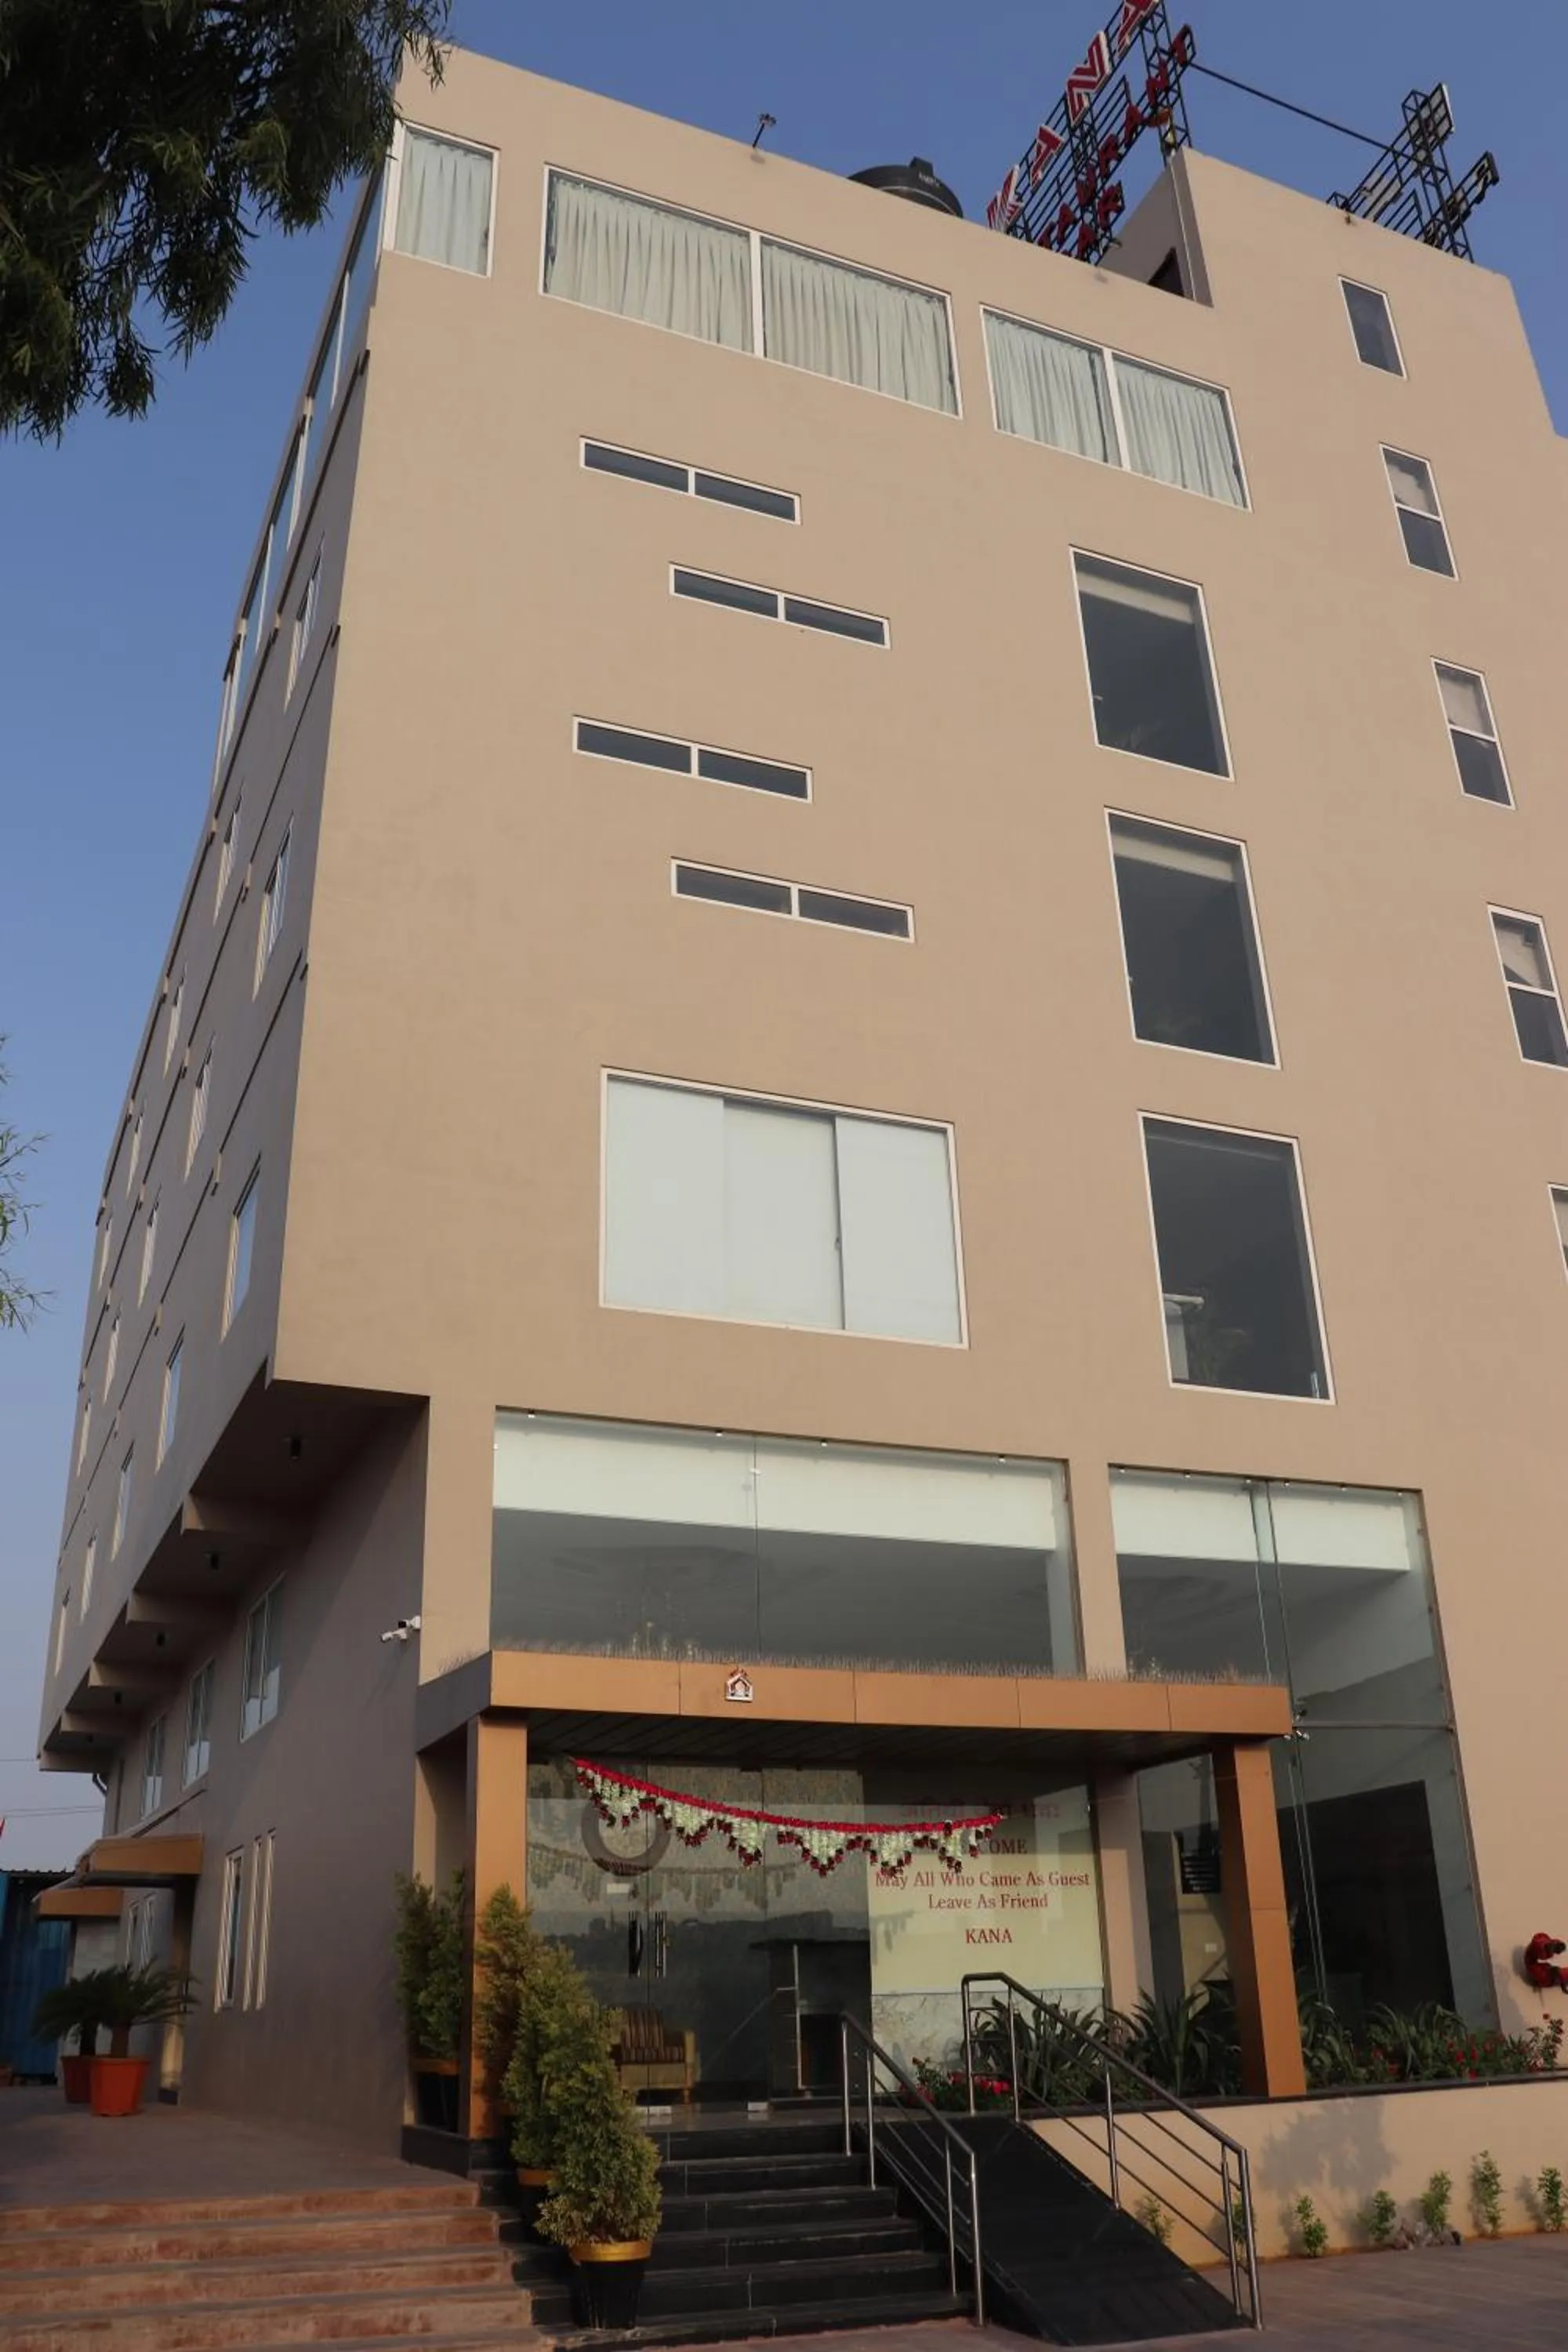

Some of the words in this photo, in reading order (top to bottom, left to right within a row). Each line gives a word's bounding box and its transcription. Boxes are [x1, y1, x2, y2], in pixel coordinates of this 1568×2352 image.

[875, 1871, 908, 1890] May
[913, 1871, 935, 1887] All
[940, 1871, 975, 1887] Who
[979, 1871, 1021, 1887] Came
[1025, 1871, 1044, 1886] As
[1049, 1871, 1090, 1886] Guest
[928, 1893, 972, 1909] Leave
[978, 1893, 996, 1909] As
[1000, 1893, 1048, 1908] Friend
[965, 1928, 1013, 1944] KANA
